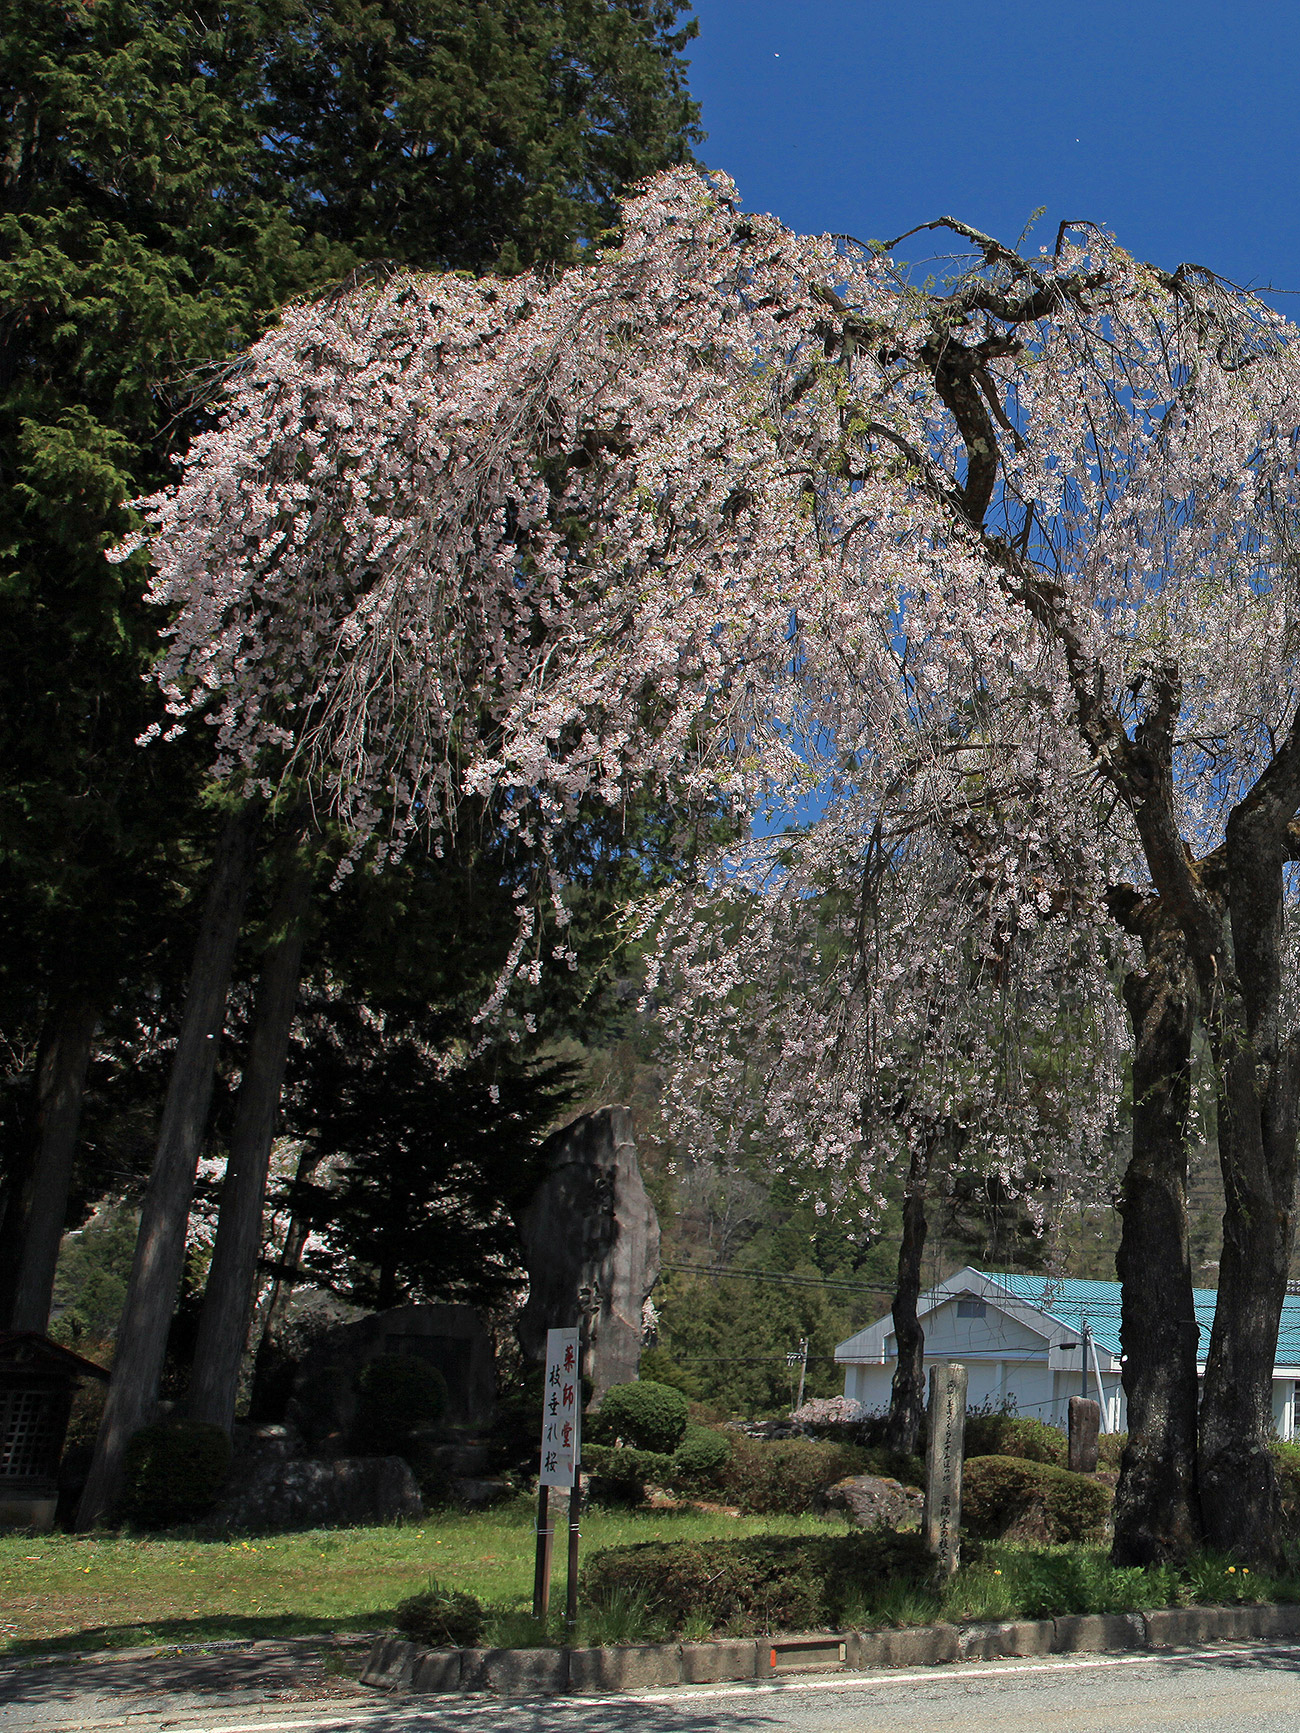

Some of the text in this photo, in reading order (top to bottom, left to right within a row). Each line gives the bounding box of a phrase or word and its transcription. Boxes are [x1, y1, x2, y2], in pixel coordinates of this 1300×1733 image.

[544, 1364, 562, 1473] 枝垂れ桜
[560, 1343, 577, 1449] 薬師堂
